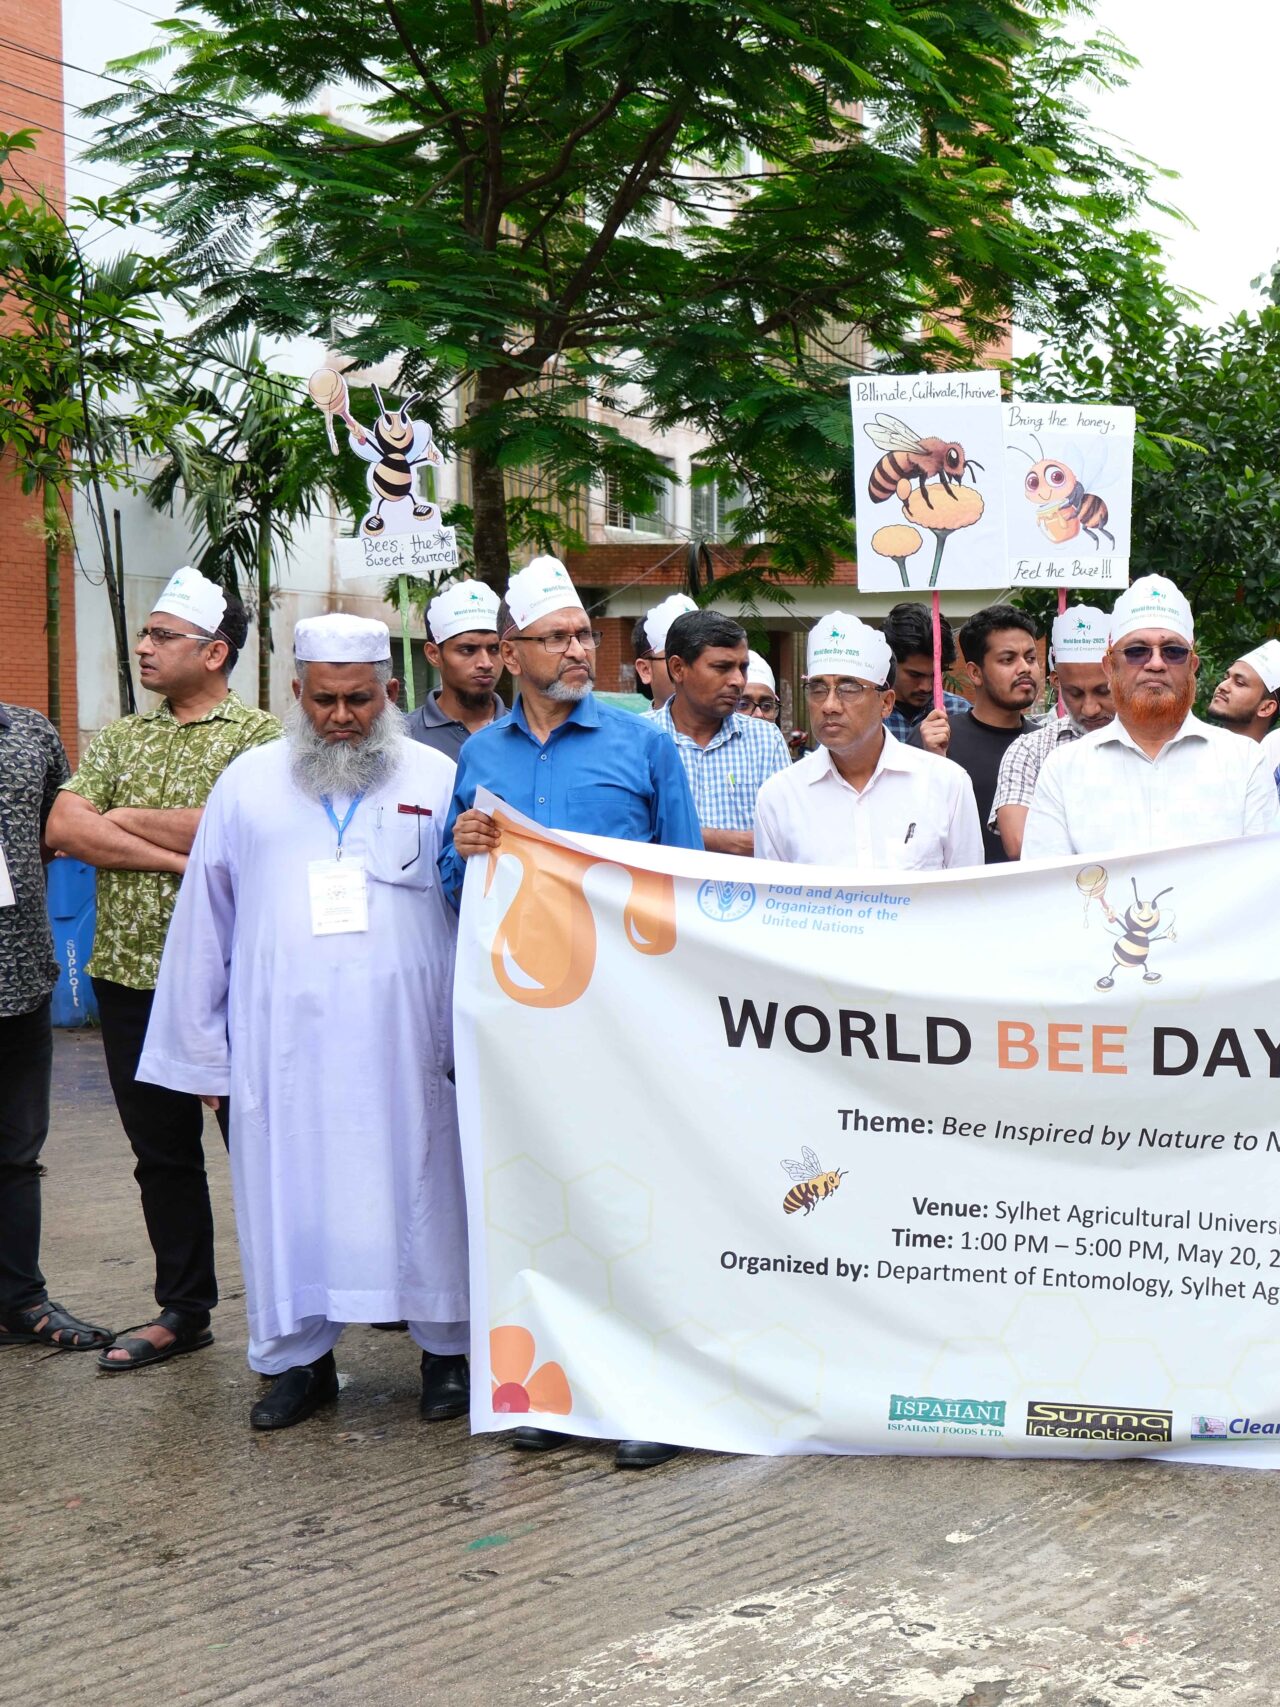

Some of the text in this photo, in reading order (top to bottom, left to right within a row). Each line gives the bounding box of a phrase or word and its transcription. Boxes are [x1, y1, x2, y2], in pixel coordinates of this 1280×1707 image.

[1008, 406, 1116, 431] Bring the honey,
[410, 534, 433, 550] the
[1014, 559, 1113, 579] Feel the Buzz!!!
[769, 884, 911, 906] Food and Agriculture
[765, 898, 898, 921] Organization of the
[762, 914, 865, 935] United Nations
[718, 995, 972, 1065] WORLD
[997, 1020, 1127, 1075] BEE
[837, 1109, 934, 1135] Theme:
[942, 1116, 987, 1138] Bee
[994, 1120, 1094, 1147] Inspired
[1101, 1124, 1130, 1151] by
[1138, 1127, 1225, 1150] Nature
[1233, 1130, 1258, 1151] to
[912, 1196, 988, 1219] Venue:
[995, 1200, 1061, 1226] Sylhet
[1066, 1203, 1190, 1229] Agricultural
[892, 1228, 954, 1249] Time:
[961, 1232, 1008, 1252] 1:00
[1014, 1234, 1049, 1254] PM
[1075, 1237, 1122, 1258] 5:00
[1128, 1240, 1170, 1265] PM,
[1177, 1243, 1223, 1269] May
[1229, 1246, 1262, 1270] 20,
[720, 1250, 828, 1276] Organized
[836, 1258, 870, 1282] by:
[877, 1260, 1008, 1285] Department
[1014, 1266, 1036, 1286] of
[1042, 1268, 1172, 1298] Entomology,
[1181, 1275, 1246, 1300] Sylhet
[895, 1400, 1001, 1420] ISPAHANI
[1030, 1404, 1171, 1429] Surma
[888, 1423, 1004, 1437] ISPAHANI FOODS LTD.
[1028, 1421, 1168, 1441] International
